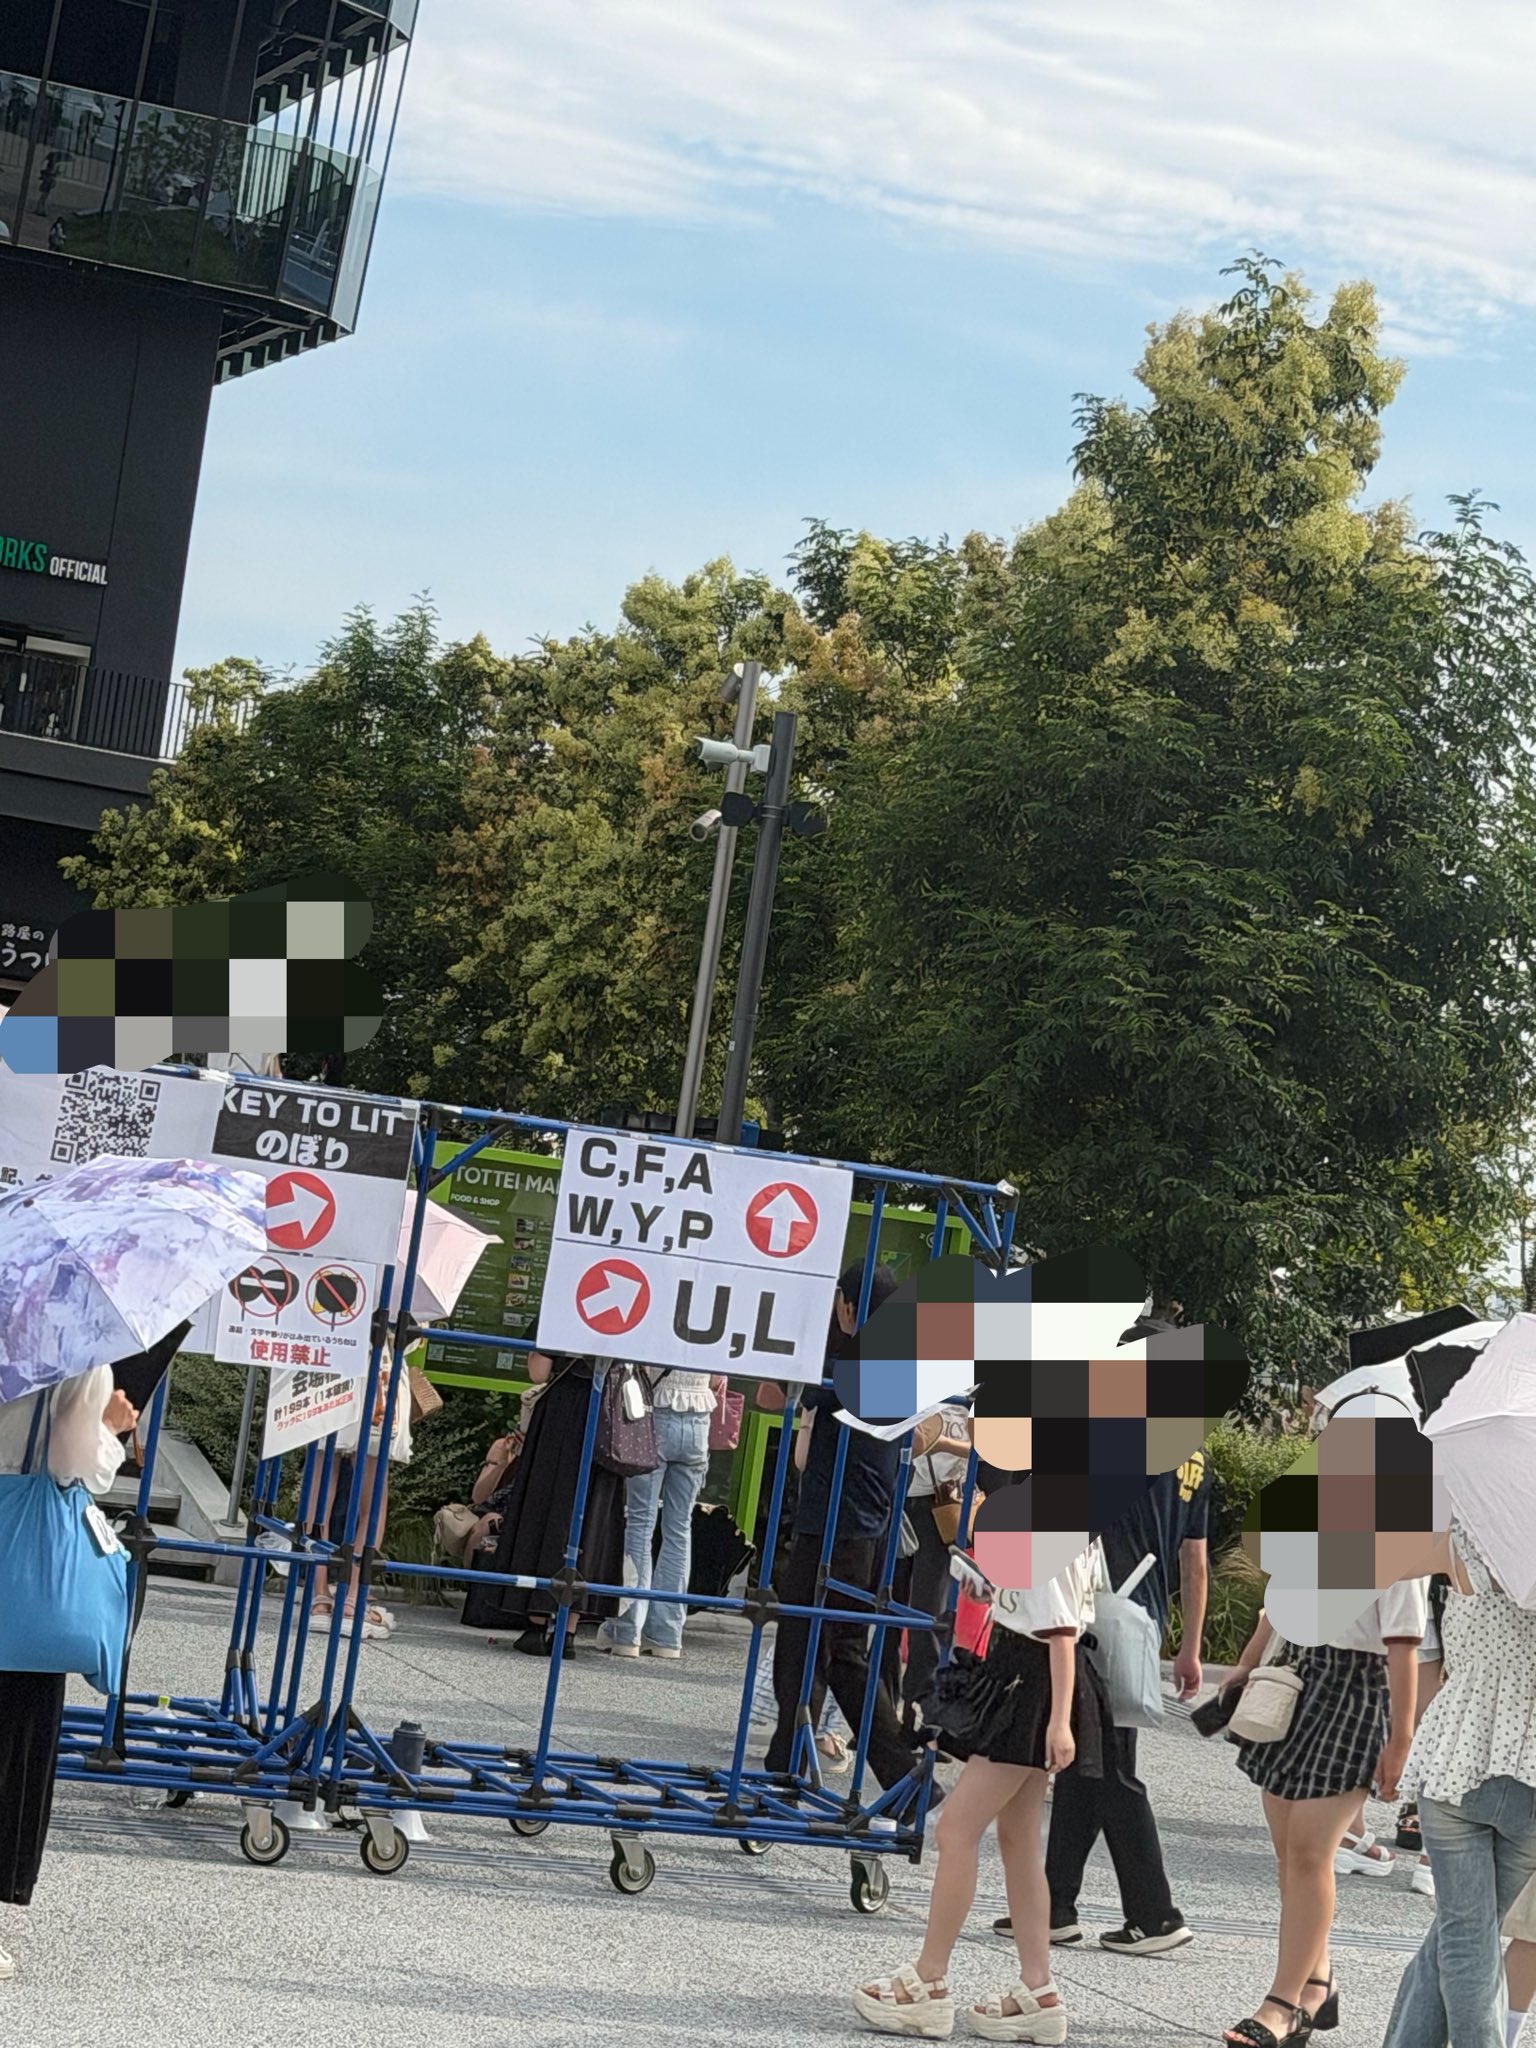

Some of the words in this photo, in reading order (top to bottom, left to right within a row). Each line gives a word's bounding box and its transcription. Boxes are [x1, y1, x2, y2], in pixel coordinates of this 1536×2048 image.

[0, 536, 47, 572] RKS
[50, 556, 108, 585] OFFICIAL
[225, 1087, 287, 1119] KEY
[297, 1097, 341, 1127] TO
[351, 1105, 405, 1136] LIT
[255, 1129, 349, 1170] のぼり
[580, 1137, 713, 1195] C,F,A
[451, 1193, 472, 1203] FOOD
[480, 1196, 500, 1206] SHOP
[456, 1166, 520, 1190] TOTTEI
[525, 1174, 560, 1195] MA
[568, 1193, 713, 1252] W,Y,P
[673, 1279, 796, 1359] U,L
[250, 1338, 331, 1367] 使用禁止
